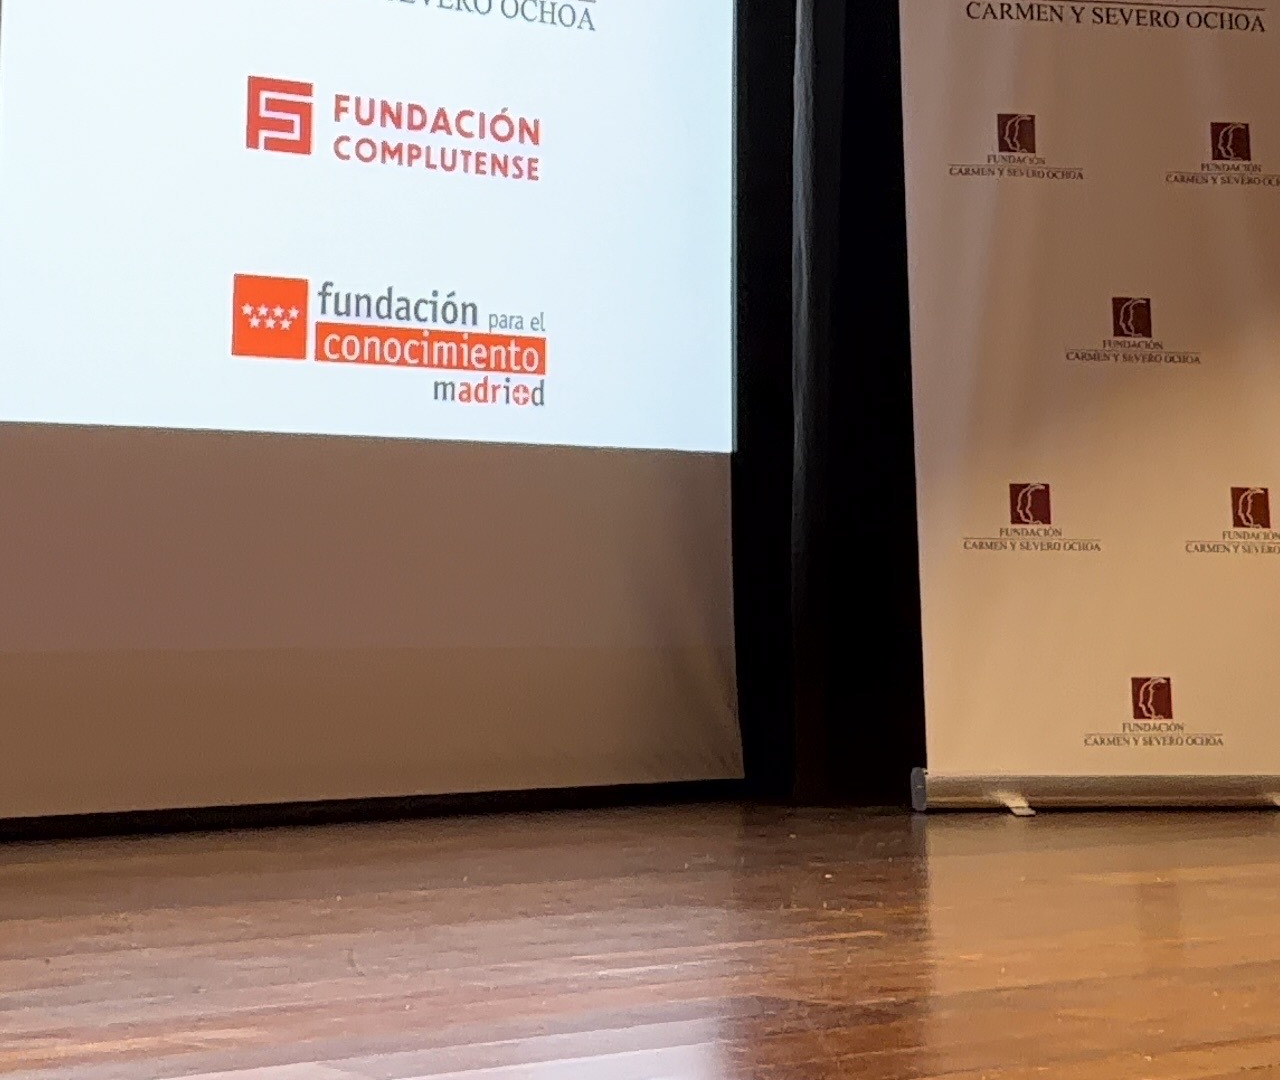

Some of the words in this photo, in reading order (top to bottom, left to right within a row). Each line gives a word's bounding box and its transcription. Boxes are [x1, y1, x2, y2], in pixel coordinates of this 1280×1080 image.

[966, 2, 1064, 22] CARMEN
[1071, 6, 1085, 24] Y
[1092, 8, 1179, 28] SEVERO
[1186, 13, 1265, 33] OCHOA
[334, 94, 540, 145] FUNDACIÓN
[333, 135, 539, 181] COMPLUTENSE
[318, 281, 478, 326] fundación
[488, 312, 523, 332] para
[530, 312, 545, 332] el
[324, 329, 539, 372] conocimiento
[1103, 339, 1163, 350] FUNDACIÓN
[999, 527, 1062, 537] FUNDACIÓN
[1084, 735, 1130, 746] CARMEN
[1133, 736, 1139, 745] Y
[1143, 735, 1183, 746] SEVERO
[1186, 736, 1224, 746] OCHOA
[1122, 722, 1184, 732] FUNDACIÓN
